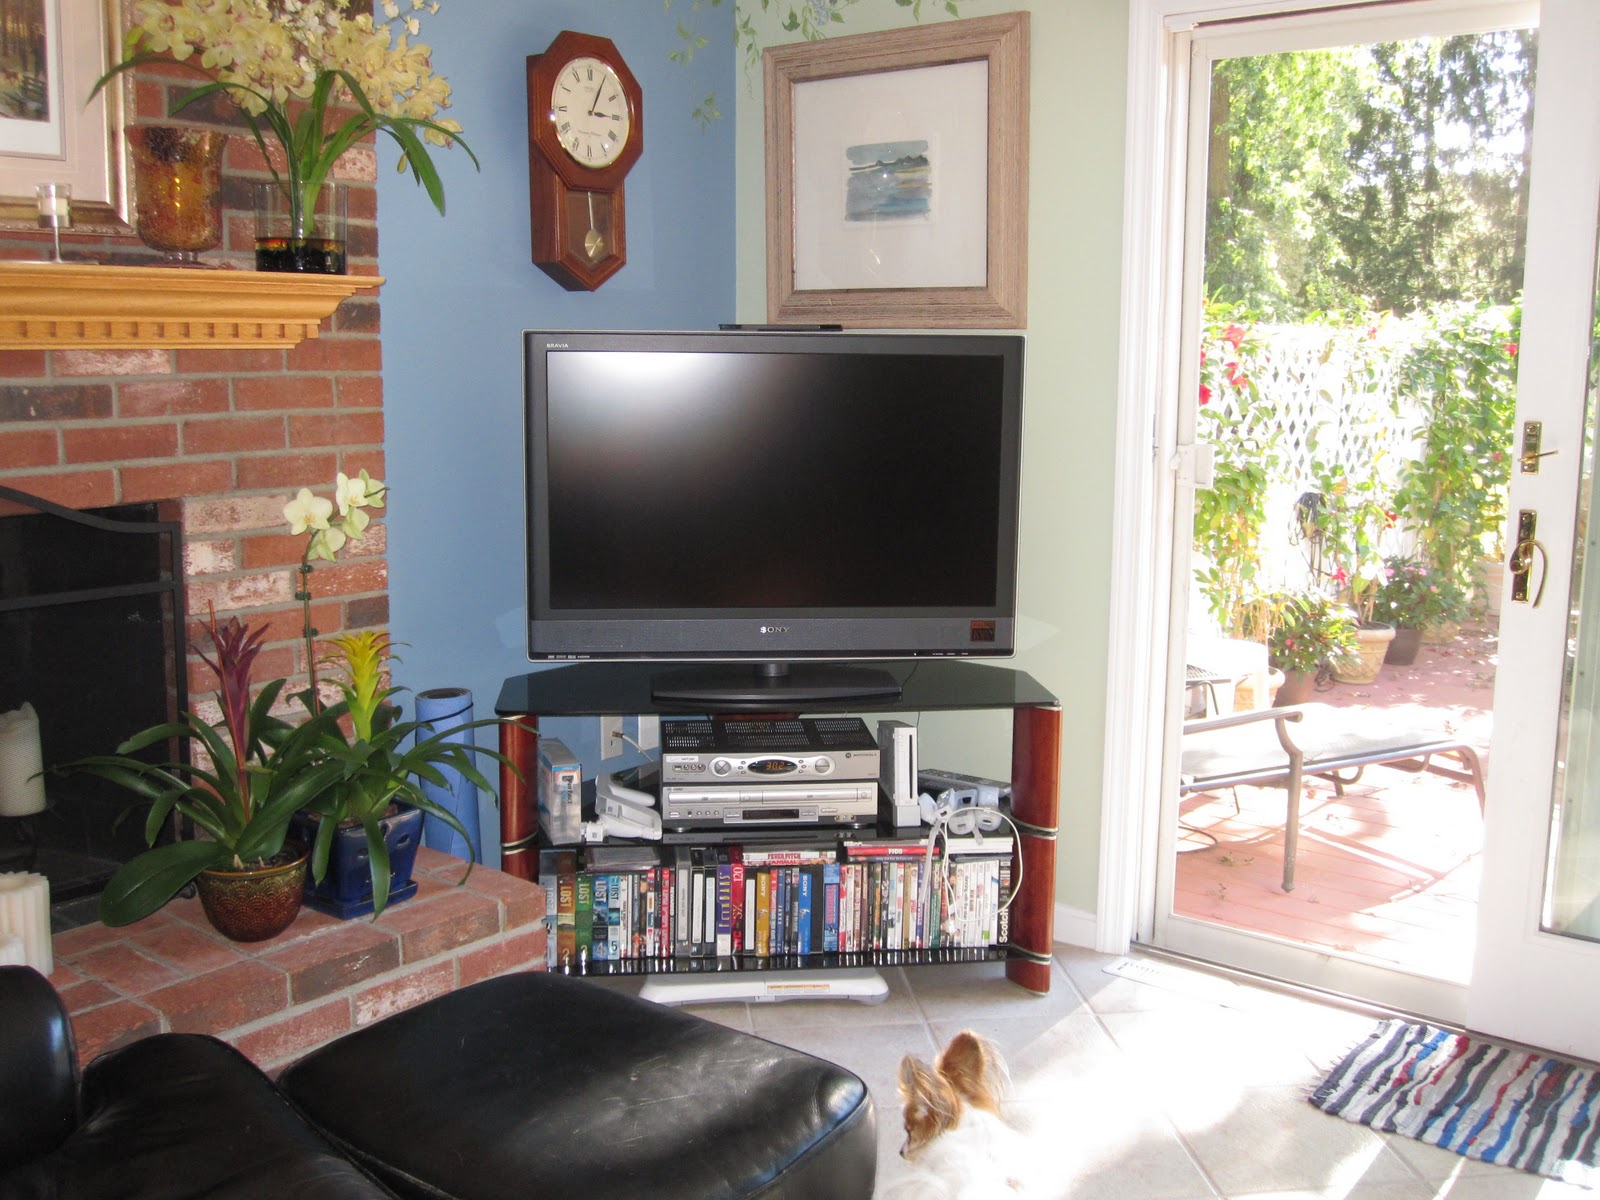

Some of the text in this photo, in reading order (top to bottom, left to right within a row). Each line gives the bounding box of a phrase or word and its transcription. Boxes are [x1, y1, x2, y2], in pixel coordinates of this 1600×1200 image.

[733, 866, 744, 882] 120
[560, 886, 572, 908] LOST
[578, 883, 590, 905] LOST
[595, 880, 607, 903] LOST
[610, 884, 619, 900] LOST
[999, 908, 1009, 943] Scotch
[596, 942, 604, 954] 4
[611, 940, 618, 952] 5
